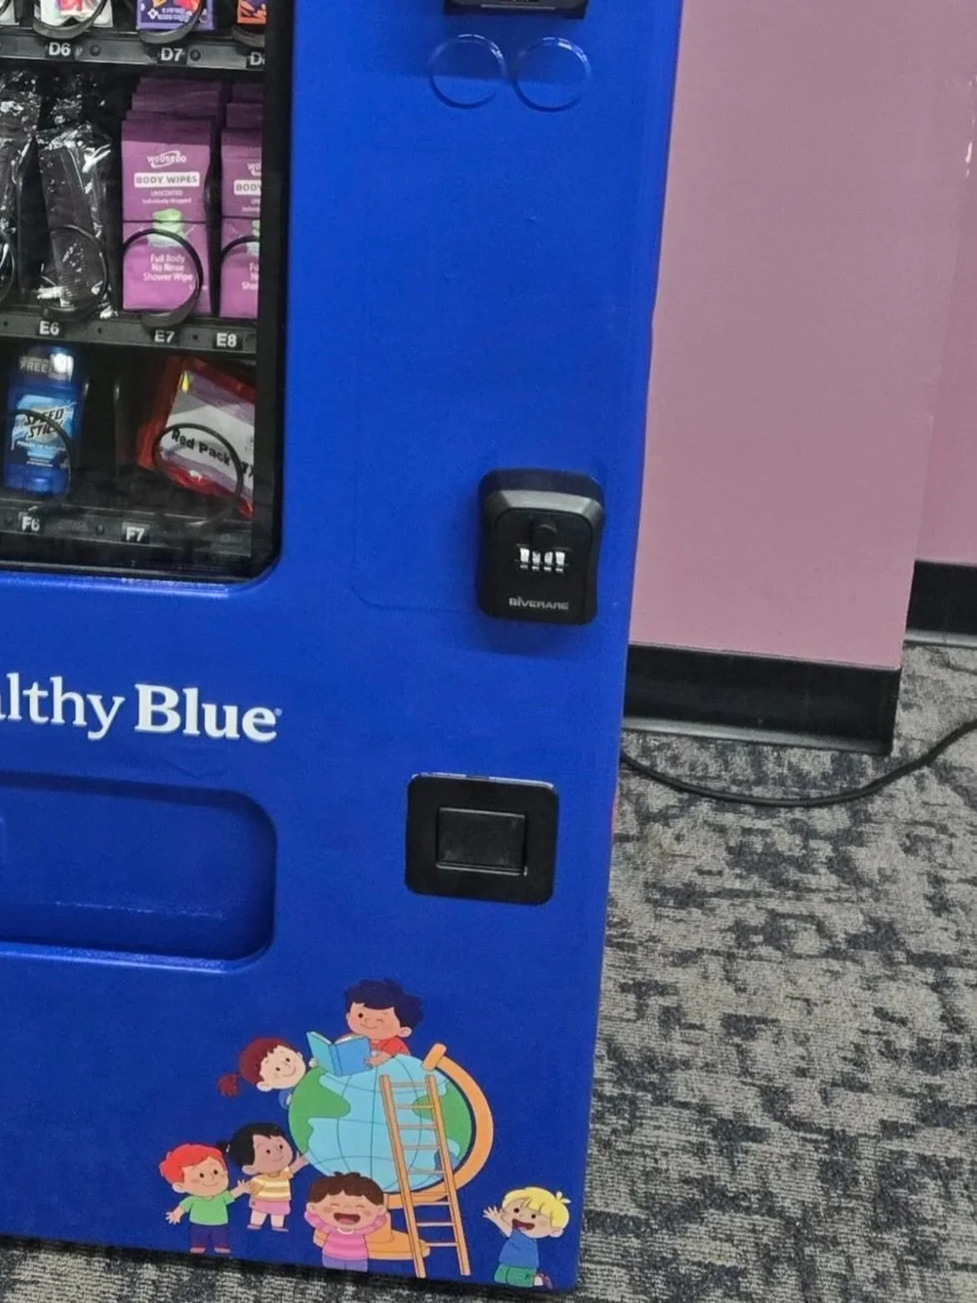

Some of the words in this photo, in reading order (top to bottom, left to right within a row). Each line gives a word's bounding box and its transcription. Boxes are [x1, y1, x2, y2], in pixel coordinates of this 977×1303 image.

[48, 42, 71, 57] D6
[160, 48, 183, 62] D7
[136, 175, 164, 184] BODY
[166, 175, 198, 184] WIPES
[166, 254, 185, 264] Body
[151, 263, 163, 272] No
[39, 321, 60, 336] E6
[153, 330, 174, 344] E7
[216, 333, 237, 348] E8
[20, 360, 49, 373] FREE
[171, 428, 195, 450] Red
[126, 527, 145, 542] F7
[133, 682, 279, 743] Blue
